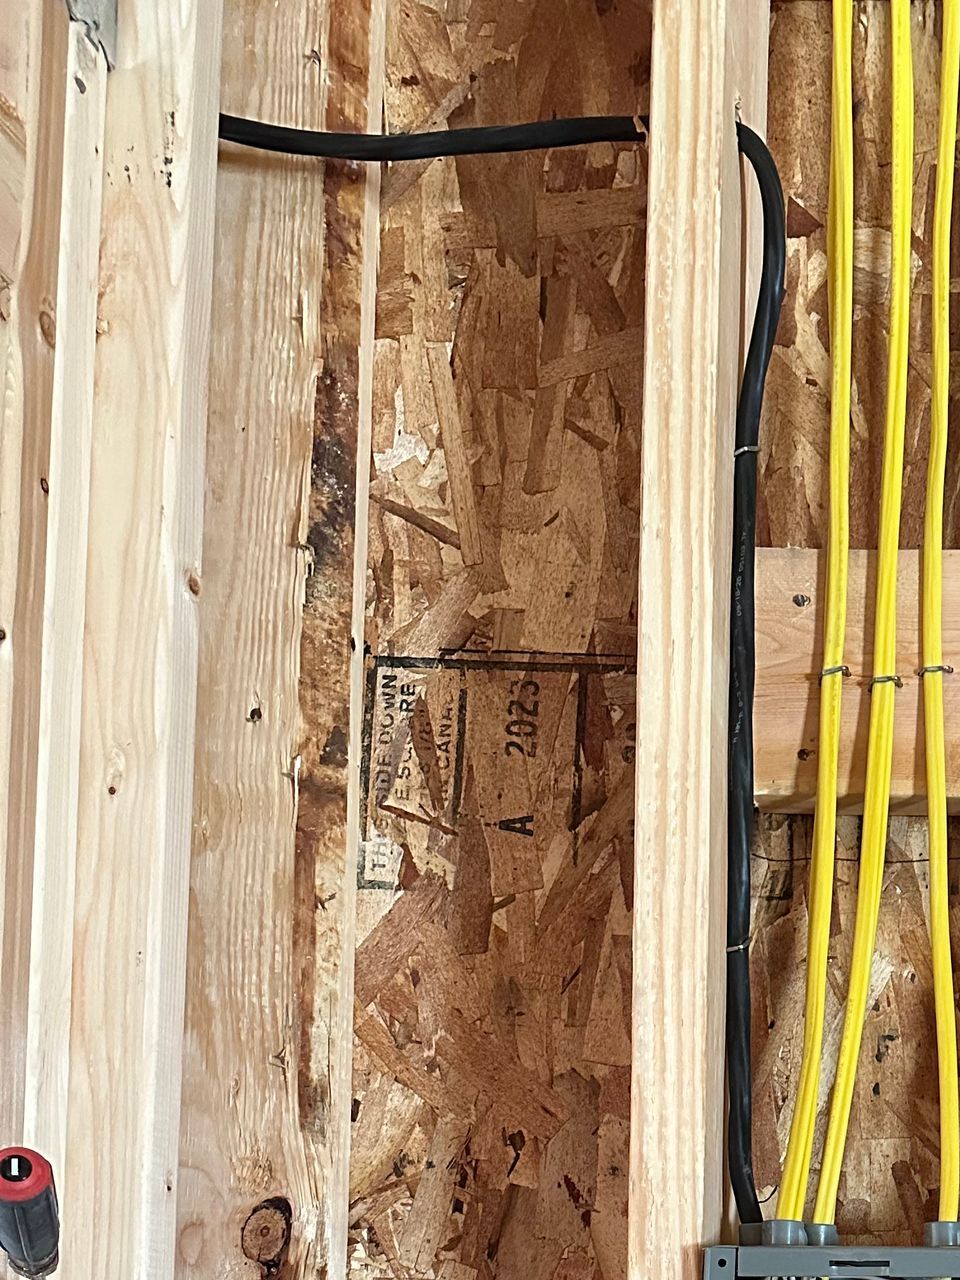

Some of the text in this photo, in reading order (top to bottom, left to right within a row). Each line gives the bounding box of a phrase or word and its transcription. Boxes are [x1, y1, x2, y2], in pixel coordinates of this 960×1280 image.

[379, 673, 398, 745] DOWN
[504, 679, 541, 758] 2023
[498, 814, 535, 838] A
